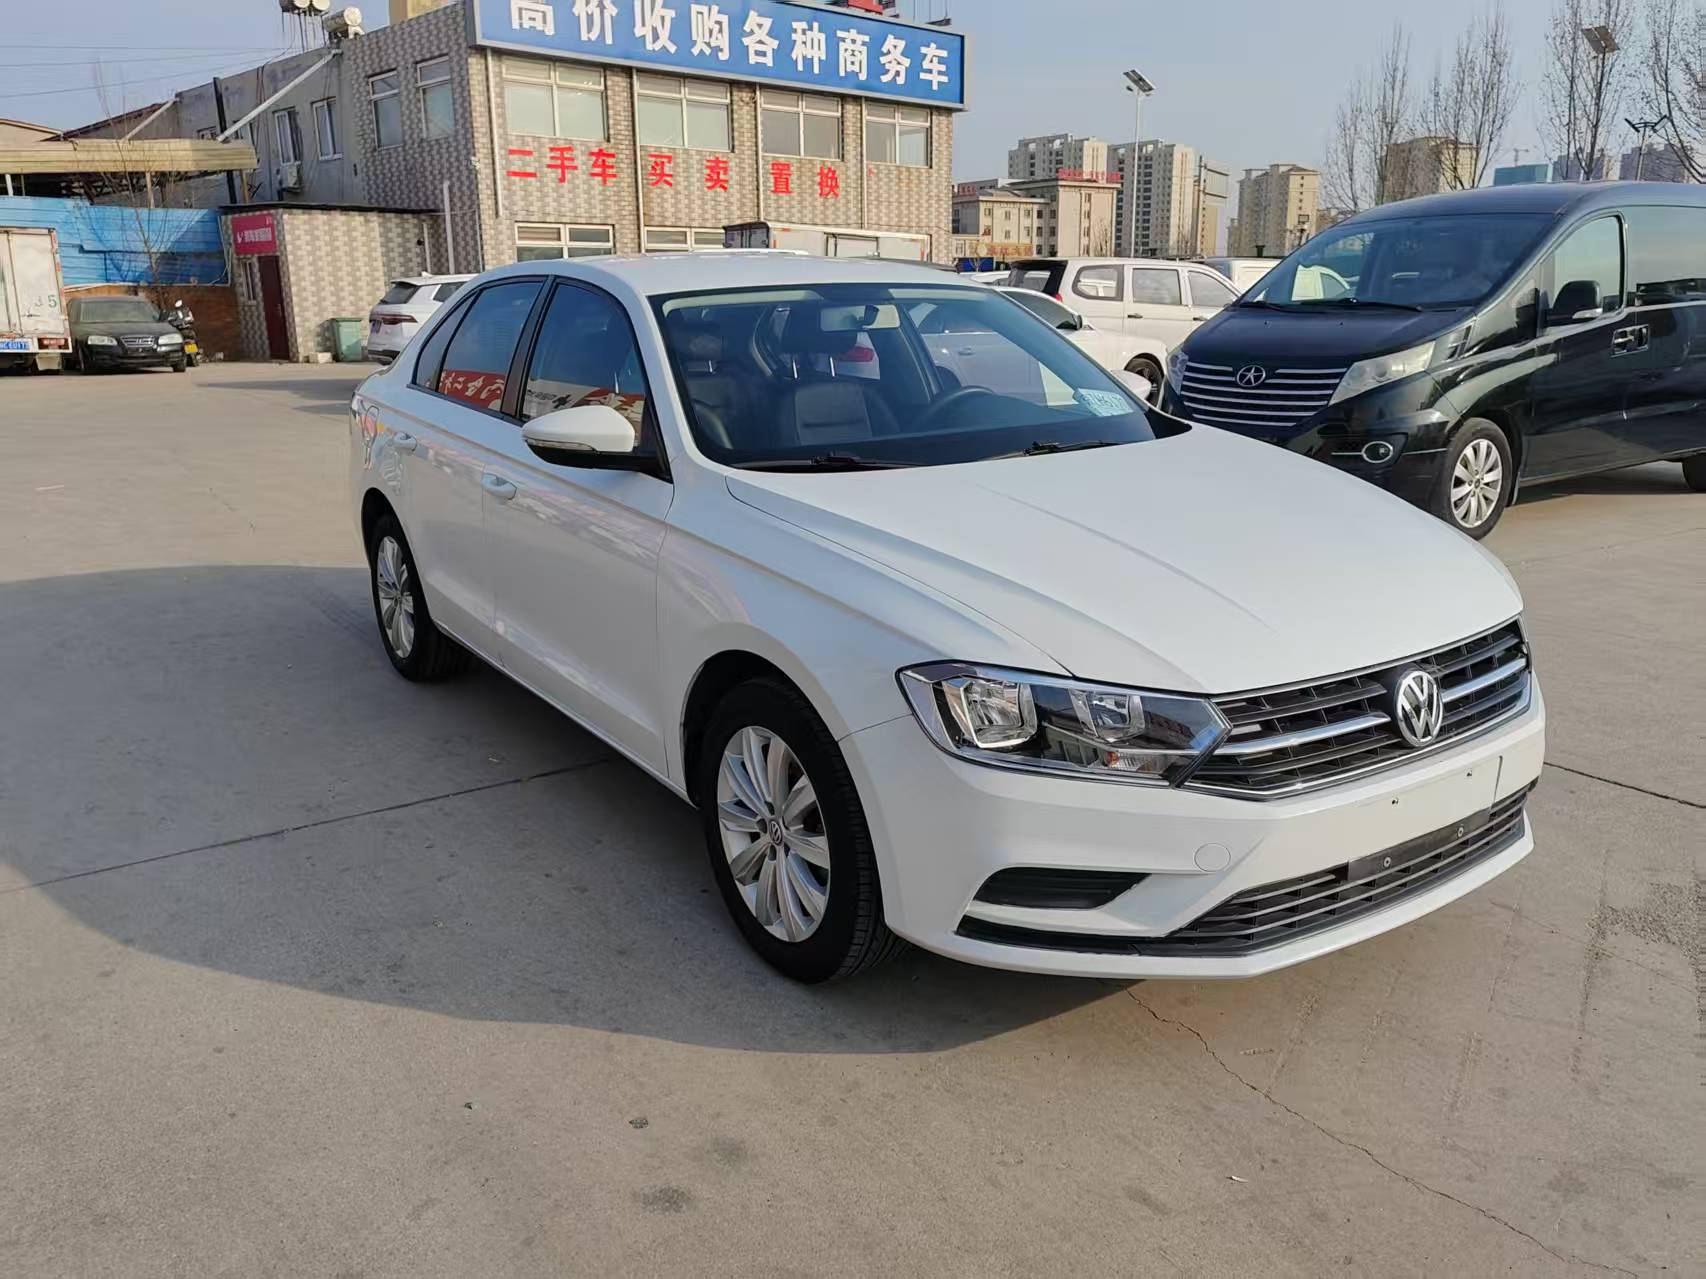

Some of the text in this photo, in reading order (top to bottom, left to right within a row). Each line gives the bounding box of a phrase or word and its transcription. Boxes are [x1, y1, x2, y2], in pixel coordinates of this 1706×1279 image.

[510, 0, 949, 90] 高价收购各种商务车
